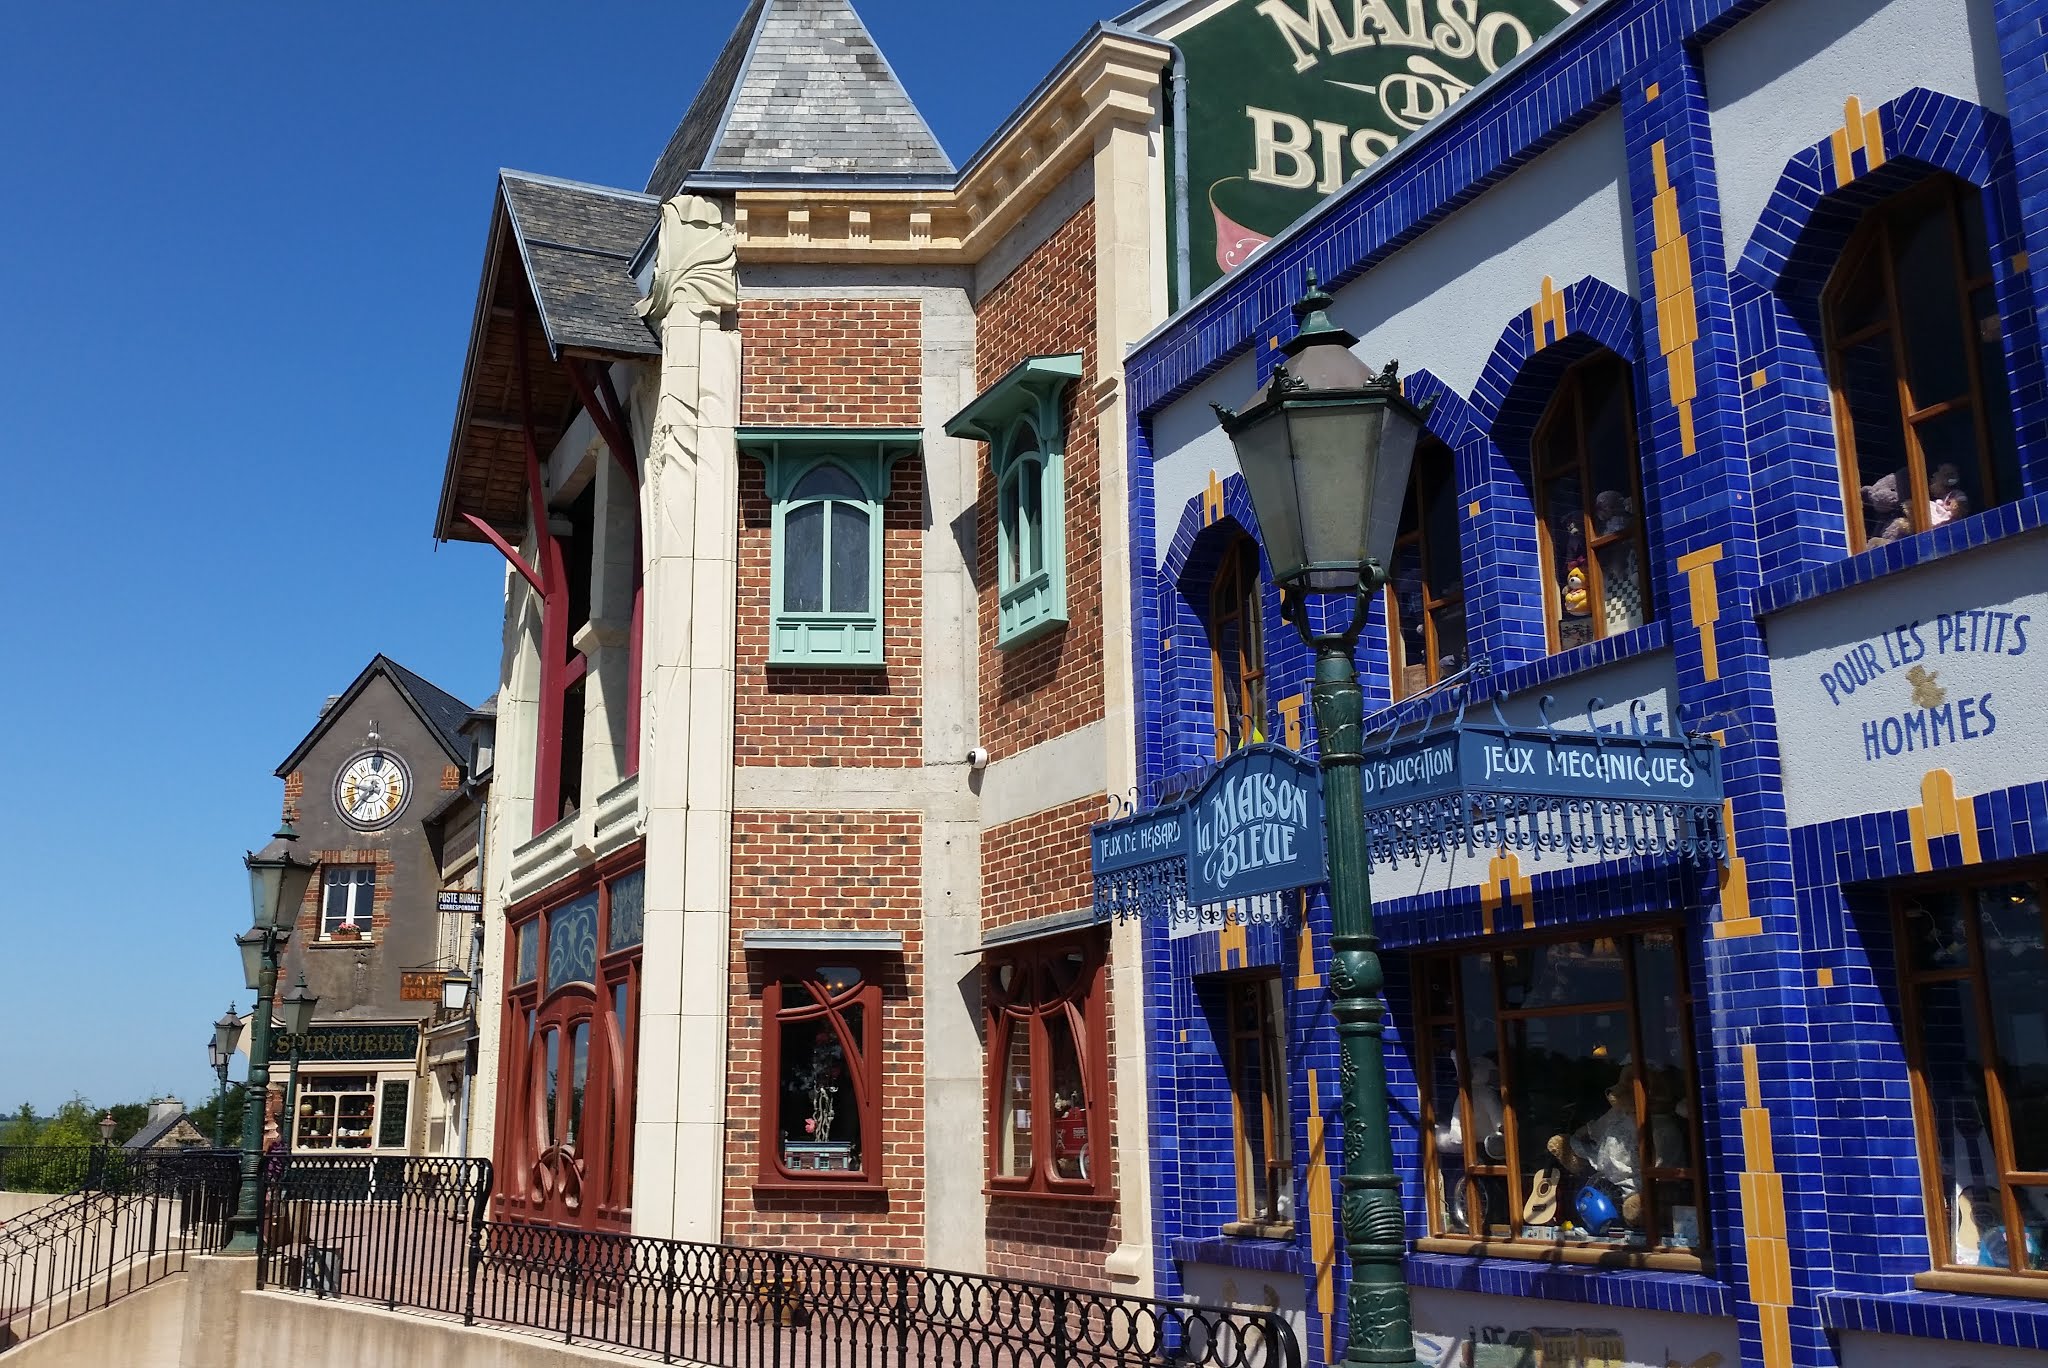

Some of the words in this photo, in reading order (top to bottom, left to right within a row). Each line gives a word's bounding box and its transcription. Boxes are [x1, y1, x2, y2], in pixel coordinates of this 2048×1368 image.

[1254, 0, 1544, 74] MAISO
[1819, 642, 1886, 706] POUR
[1882, 620, 1926, 669] LES
[1936, 610, 2031, 656] PETITS
[1861, 692, 1997, 761] HOMMES
[1364, 747, 1453, 792] D'ÉDUCATION
[1483, 745, 1536, 781] JEUX
[1546, 749, 1695, 788] MÉCANIQUES
[1101, 834, 1122, 863] JEUX
[1140, 820, 1181, 852] HASARD
[1204, 772, 1308, 882] MAISON
[1217, 816, 1298, 890] BLEUE
[438, 892, 458, 903] POSTE
[459, 893, 482, 904] RURALE
[276, 1033, 406, 1054] SPIRITUEUX
